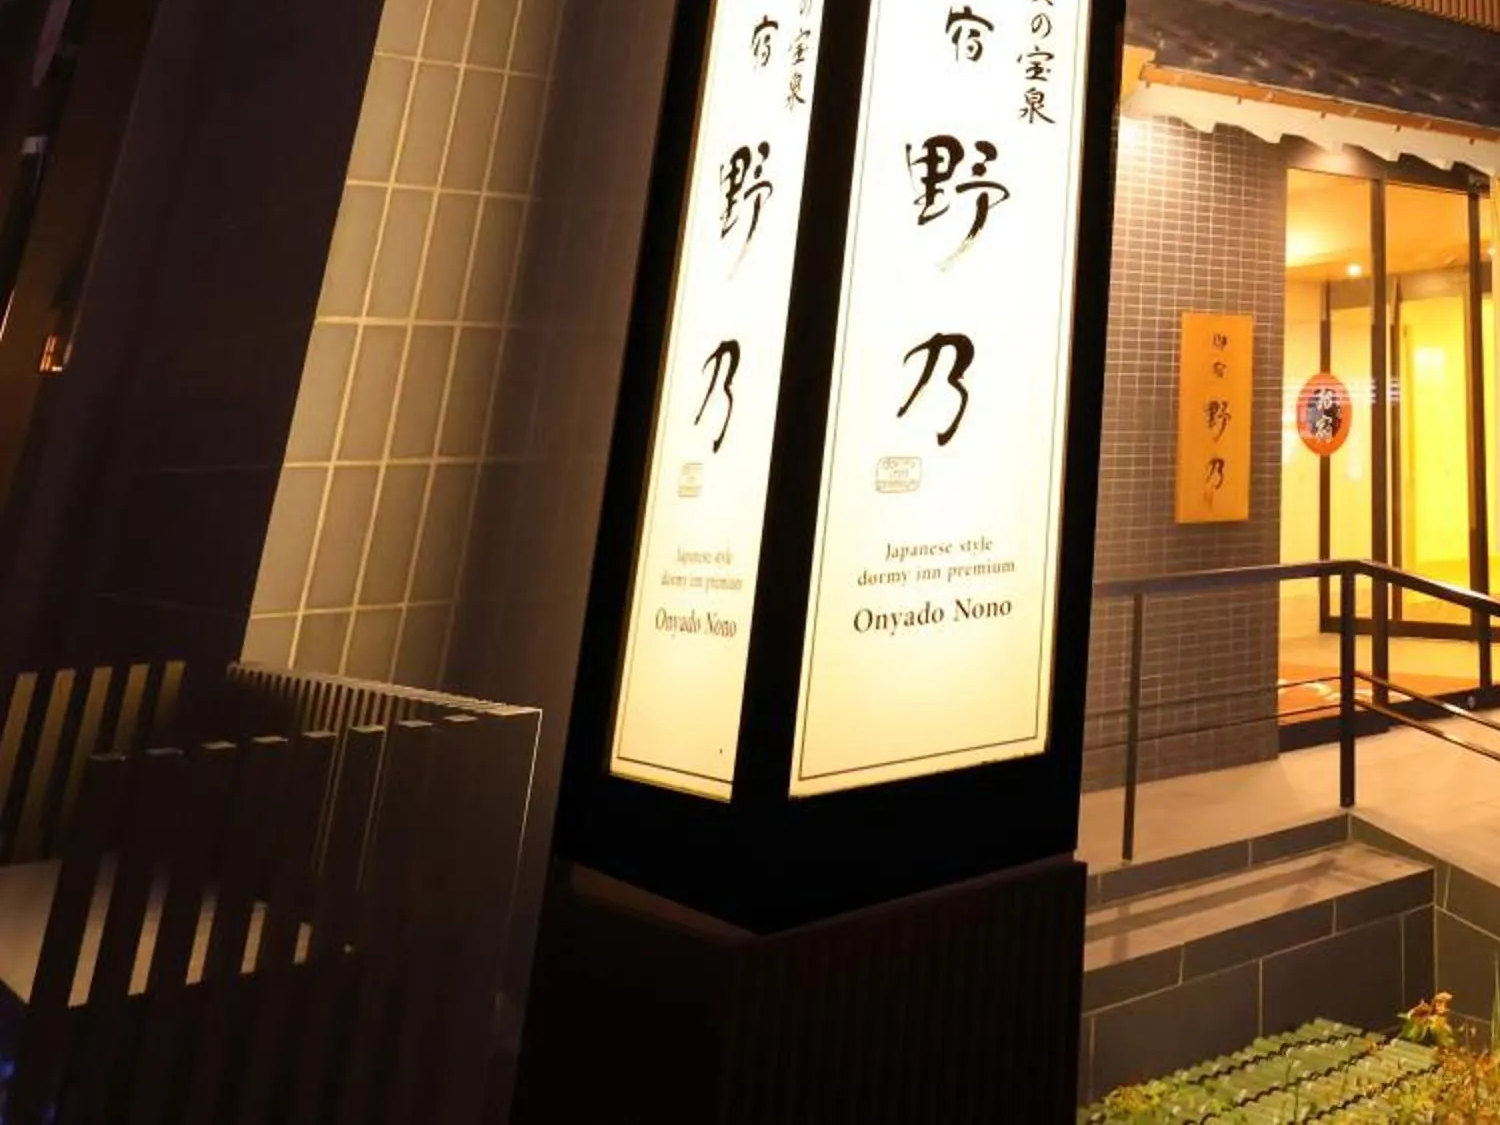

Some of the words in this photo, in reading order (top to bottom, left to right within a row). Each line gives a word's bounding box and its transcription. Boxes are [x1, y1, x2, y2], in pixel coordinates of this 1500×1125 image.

[694, 141, 773, 453] 野乃
[896, 134, 1010, 447] 野乃
[885, 542, 953, 562] Japanese
[959, 535, 993, 556] style
[857, 568, 909, 587] dormy
[916, 565, 942, 582] inn
[947, 558, 1015, 583] premium
[655, 606, 701, 640] Onyado
[705, 611, 737, 638] Nono
[853, 601, 945, 637] Onyado
[953, 597, 1013, 623] Nono
